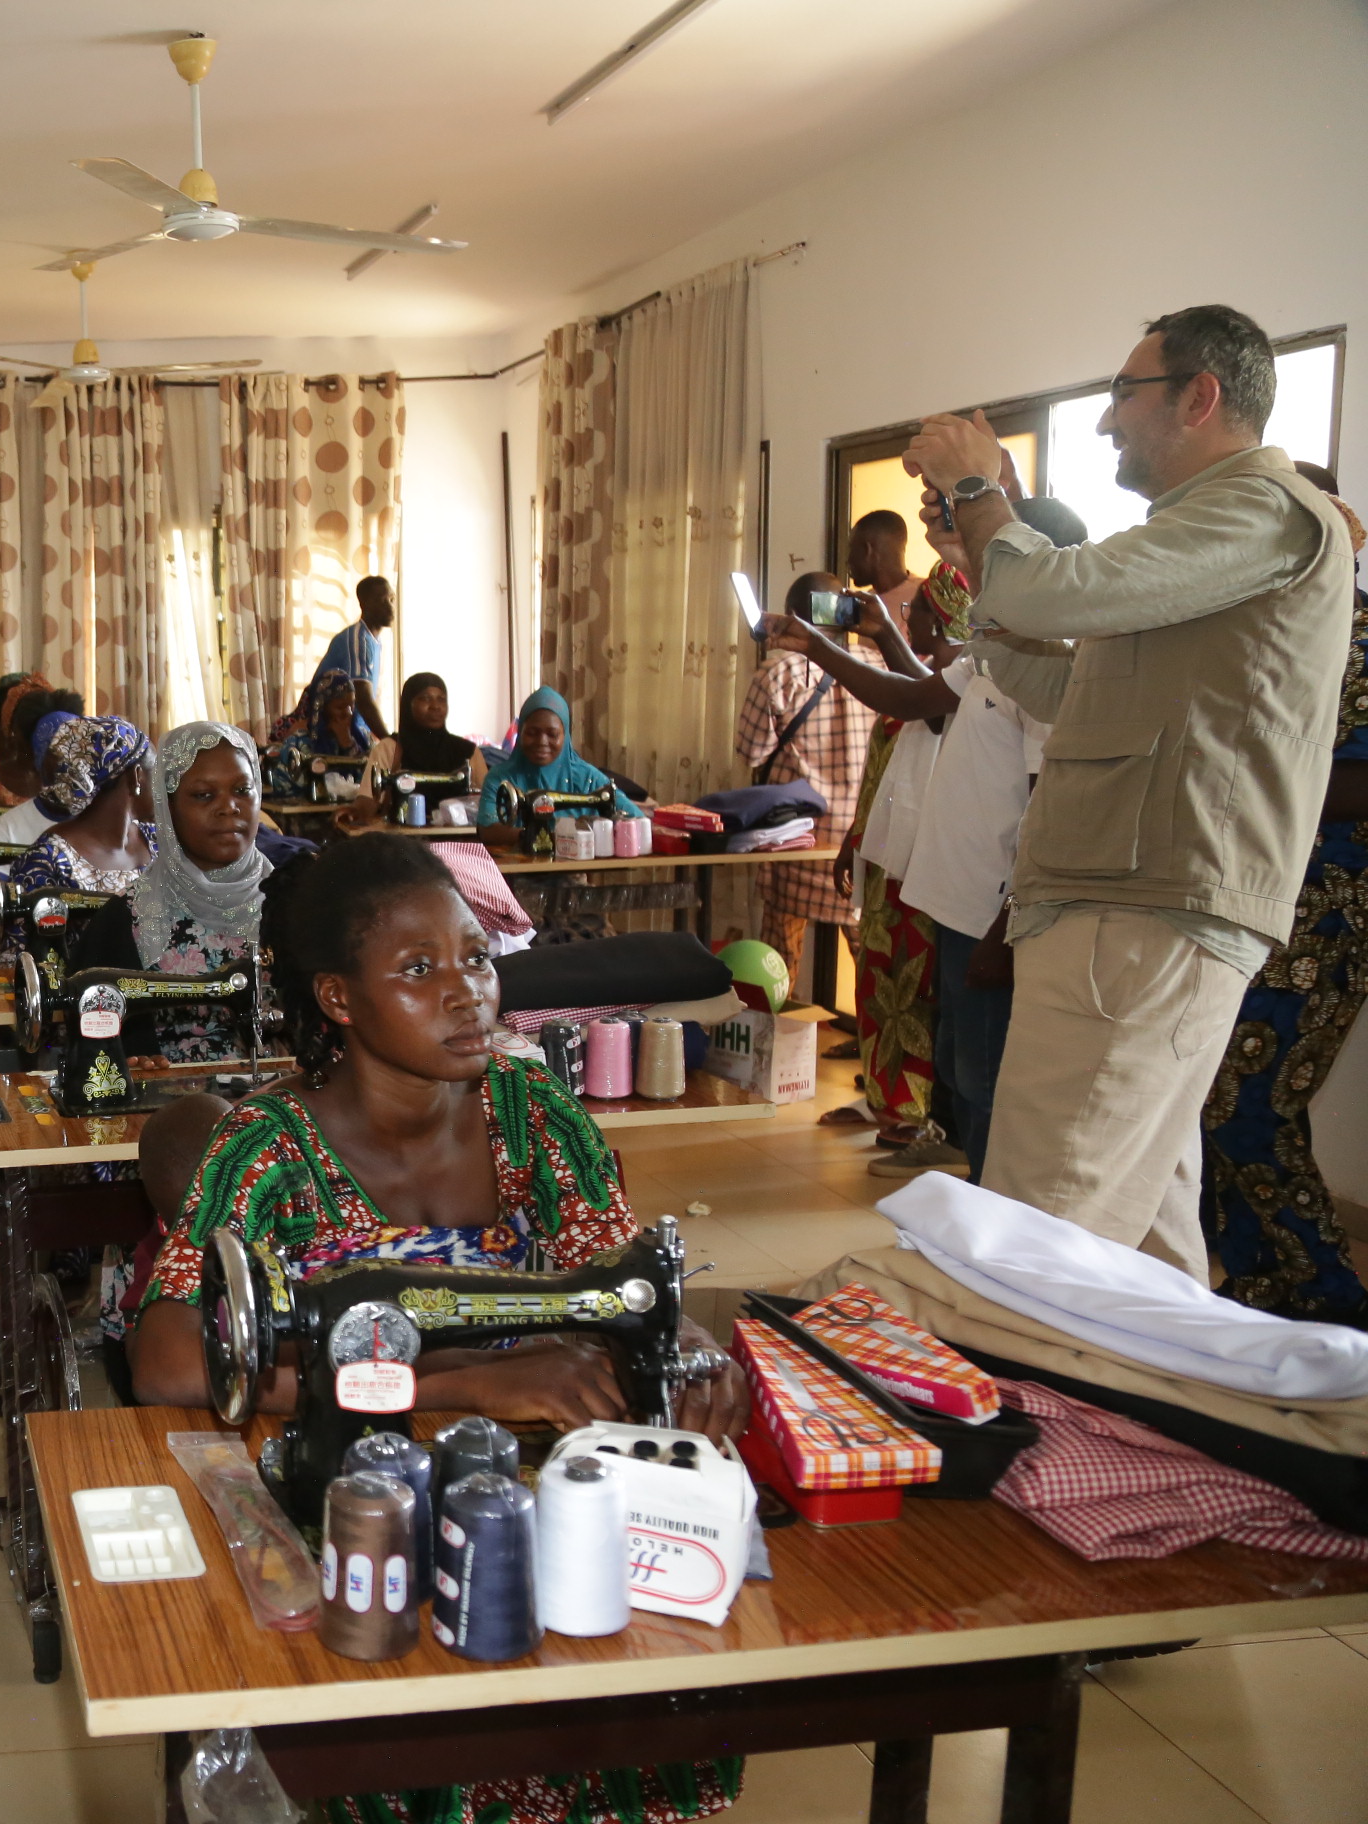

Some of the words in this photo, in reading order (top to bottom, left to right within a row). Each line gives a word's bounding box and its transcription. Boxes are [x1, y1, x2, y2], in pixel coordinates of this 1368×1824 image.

[473, 1316, 529, 1325] FLYING
[533, 1315, 564, 1324] MAN
[645, 1514, 690, 1534] QUALITY
[693, 1524, 720, 1541] HIGH
